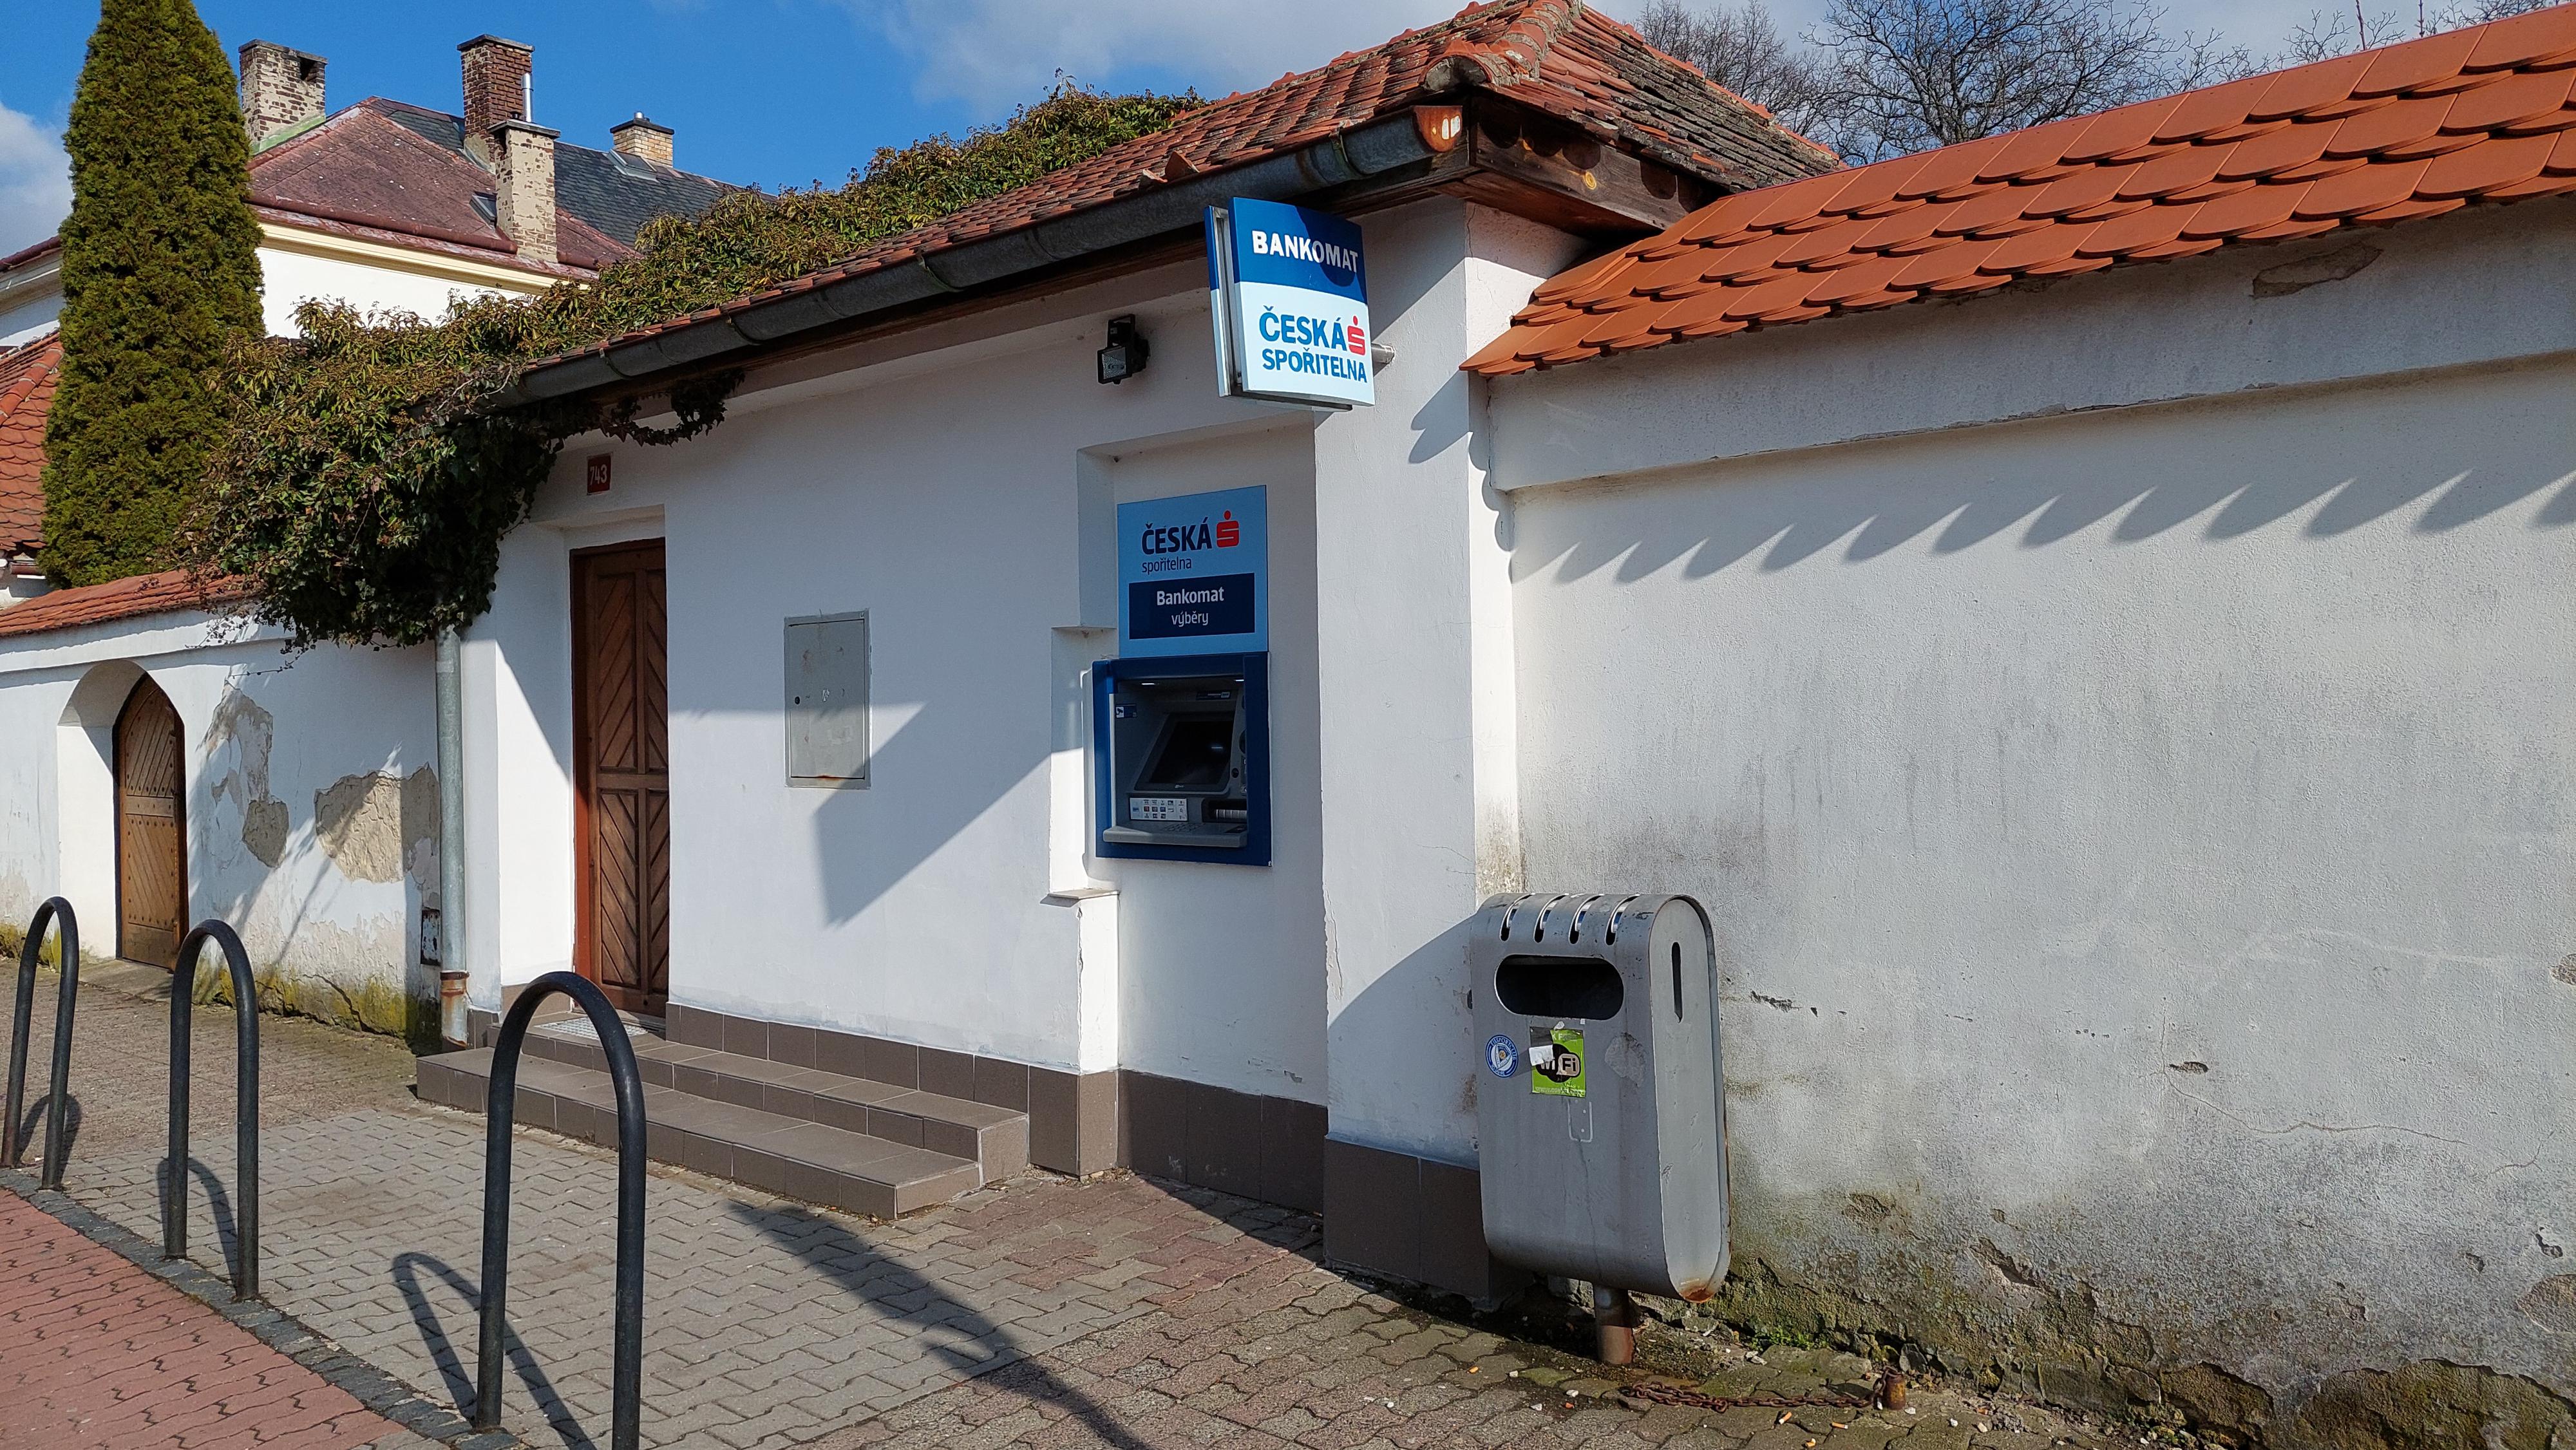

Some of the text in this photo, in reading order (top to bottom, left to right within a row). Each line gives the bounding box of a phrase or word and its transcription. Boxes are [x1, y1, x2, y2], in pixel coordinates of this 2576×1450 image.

[1252, 230, 1358, 273] BANKOMAT
[1259, 305, 1347, 352] ČESKÁ
[1262, 348, 1367, 382] SPOŘITELNA
[590, 464, 607, 485] 743
[1141, 516, 1213, 555] ČESKÁ
[1141, 556, 1192, 575] spořitelna
[1157, 587, 1225, 606] Bankomat
[1171, 610, 1209, 627] výběry
